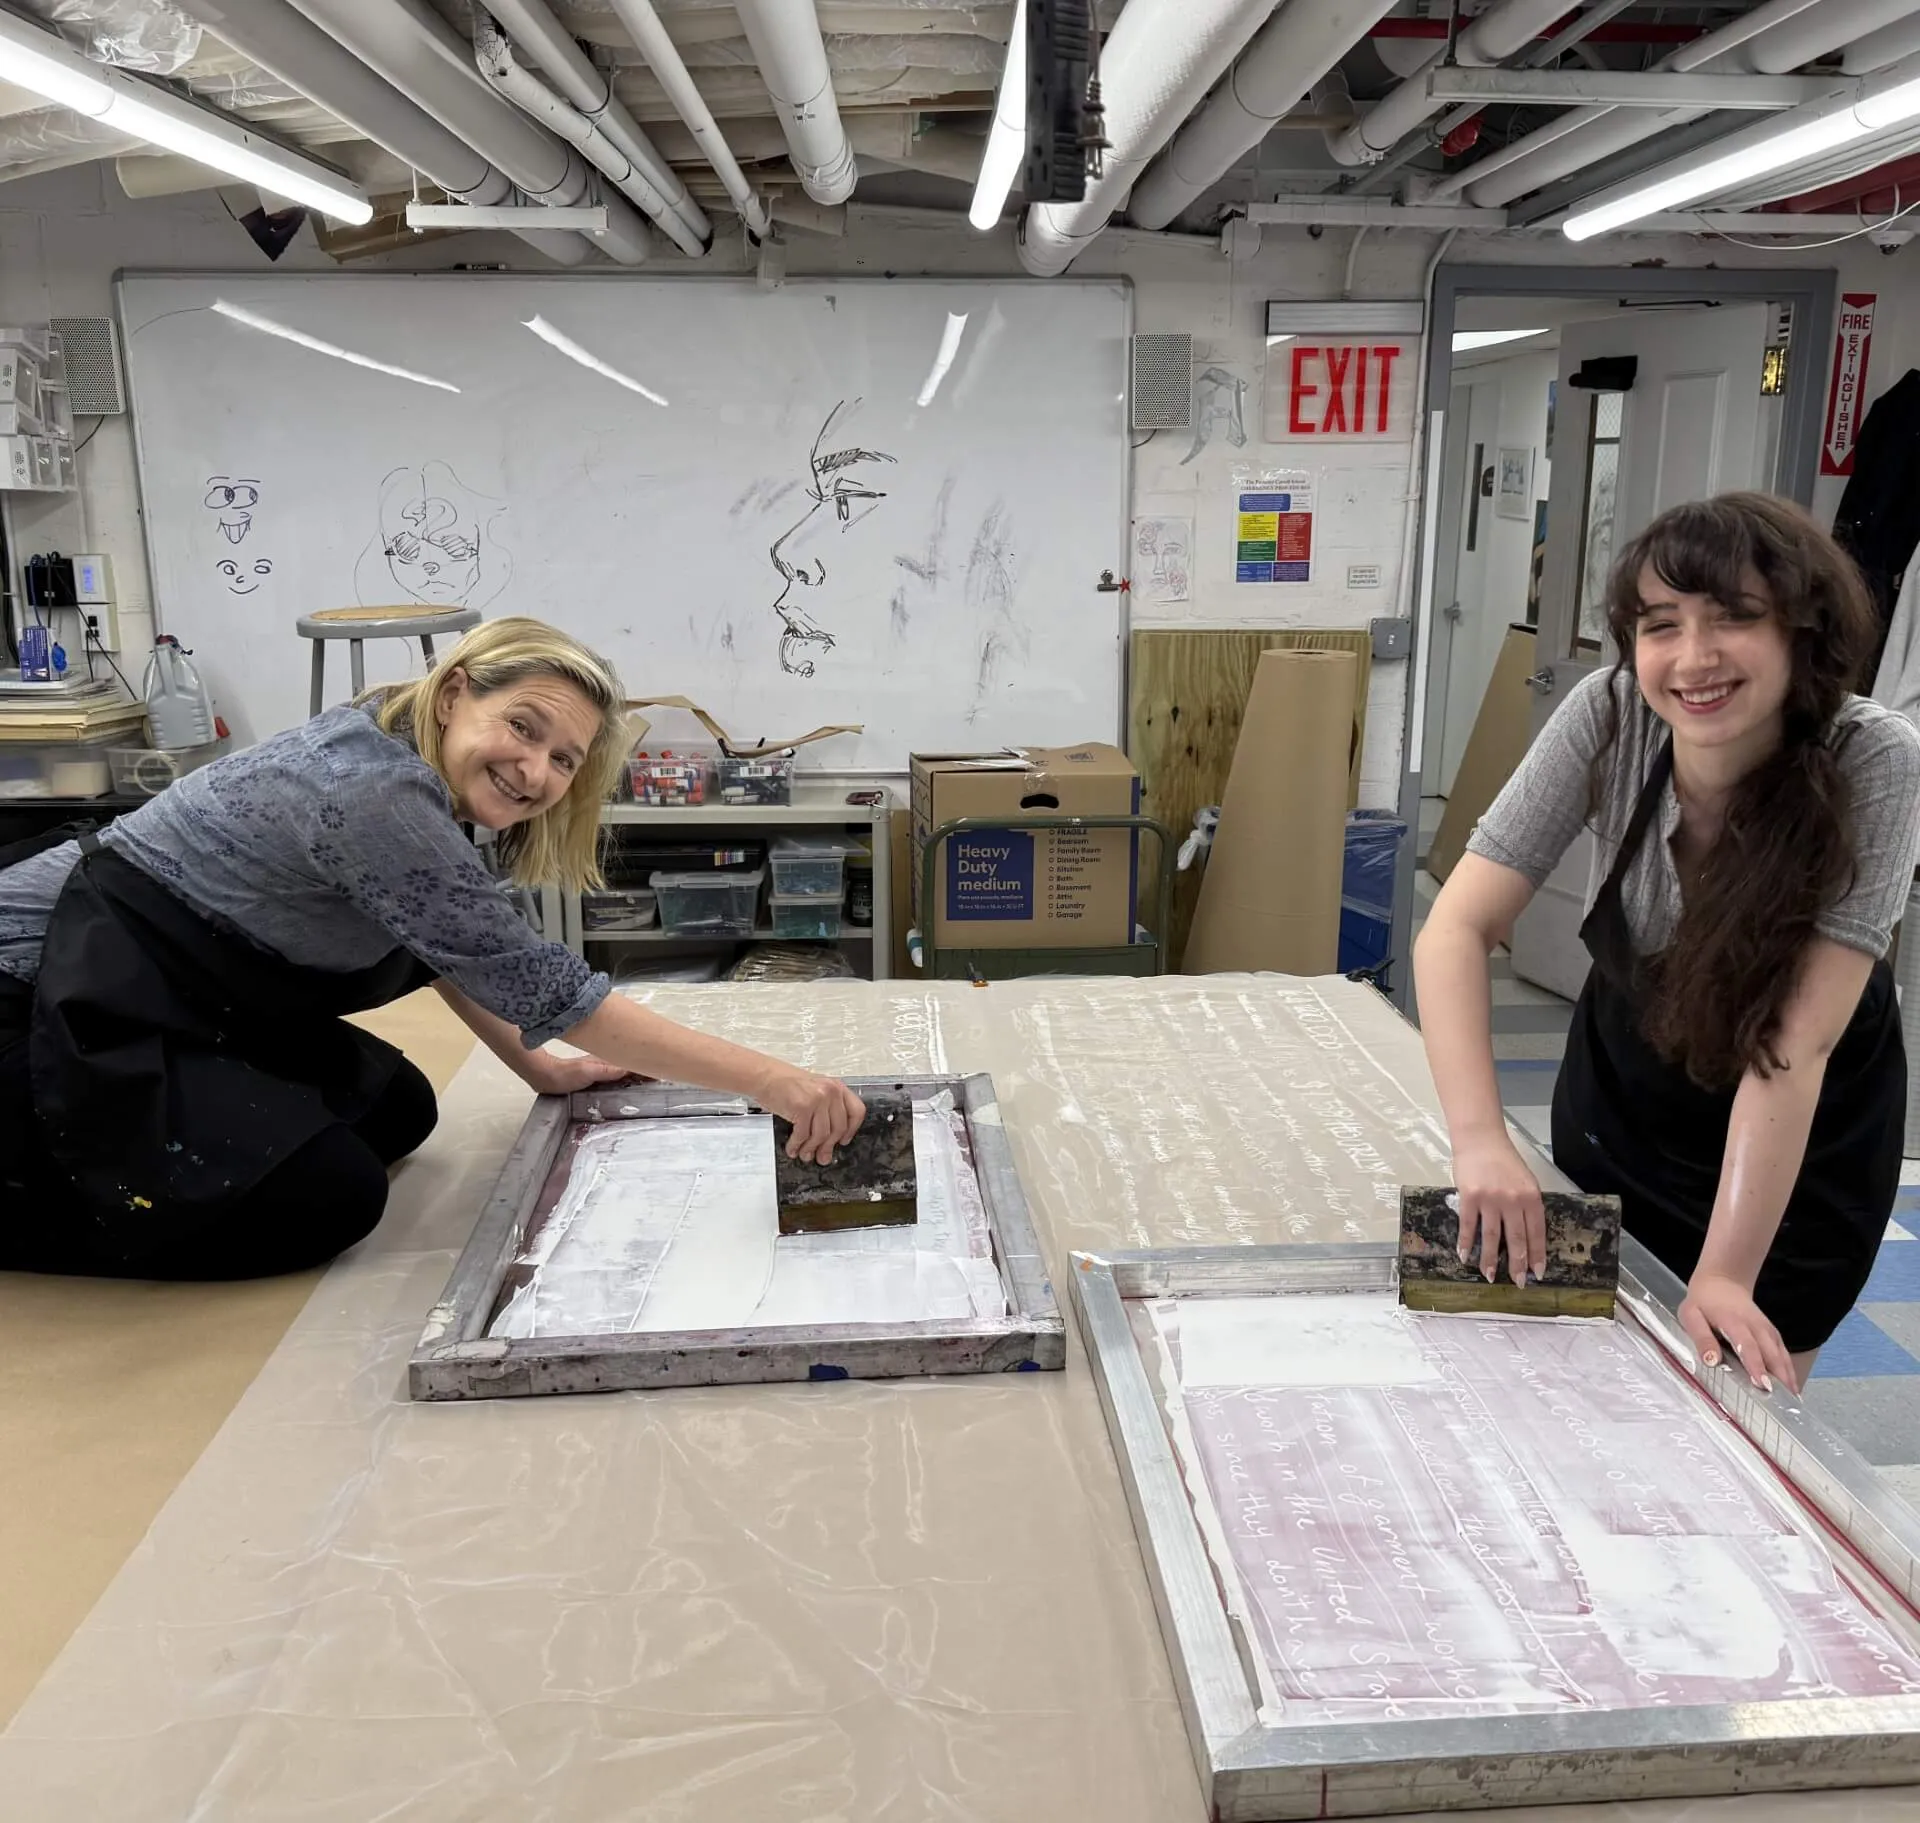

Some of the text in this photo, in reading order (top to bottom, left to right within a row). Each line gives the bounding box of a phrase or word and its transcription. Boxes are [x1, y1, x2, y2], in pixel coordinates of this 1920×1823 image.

[1841, 314, 1871, 330] FIRE
[1289, 347, 1400, 432] EXIT
[1835, 334, 1860, 450] EXTINGUISHER
[957, 844, 1010, 860] Heavy
[1057, 828, 1088, 836] FRAGILE
[958, 860, 998, 876] Duty
[958, 877, 1021, 891] medium
[1056, 902, 1086, 910] Laundry
[1056, 911, 1083, 919] Garage
[1508, 1351, 1558, 1398] main
[1551, 1406, 1614, 1461] cause
[1606, 1469, 1657, 1495] of
[1598, 1344, 1633, 1362] of
[1616, 1366, 1668, 1421] whom
[1669, 1431, 1705, 1462] are
[1216, 1431, 1249, 1484] since
[1273, 1462, 1304, 1482] in
[1339, 1463, 1385, 1488] of
[1236, 1490, 1276, 1539] they
[1283, 1492, 1331, 1531] the
[1337, 1492, 1443, 1603] garment
[1460, 1513, 1514, 1568] that
[1266, 1558, 1316, 1610] don't
[1312, 1546, 1375, 1625] United
[1285, 1615, 1318, 1684] have
[1349, 1643, 1407, 1719] State
